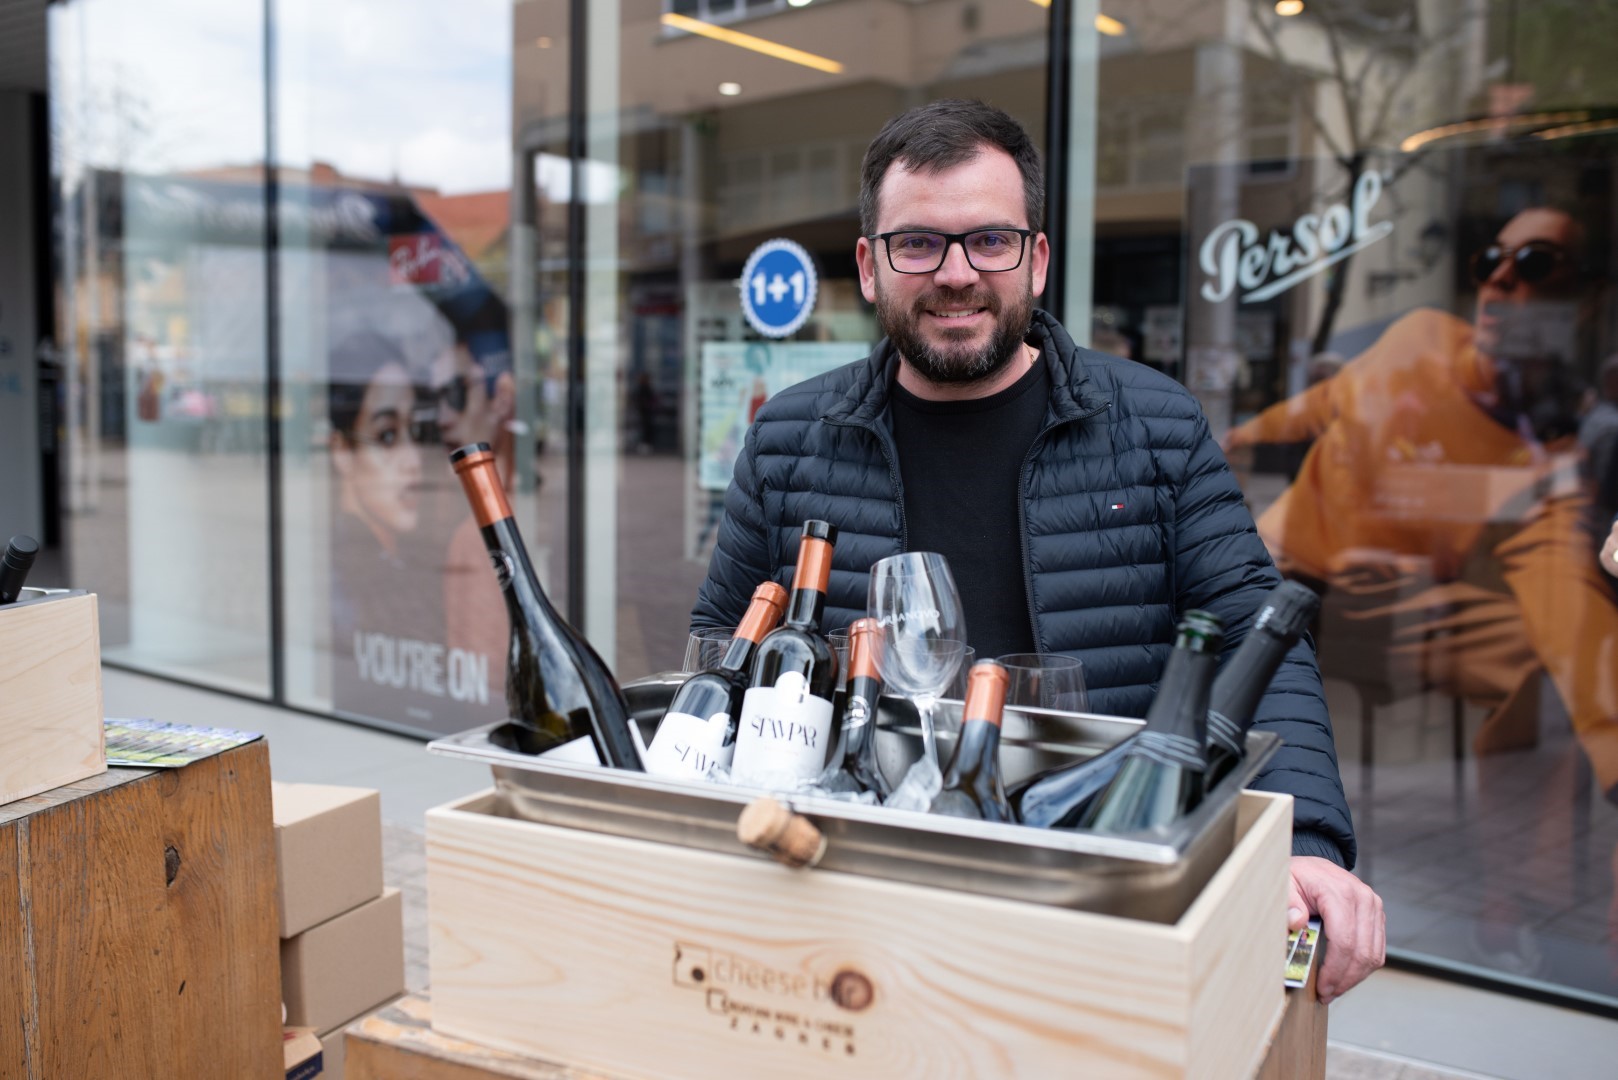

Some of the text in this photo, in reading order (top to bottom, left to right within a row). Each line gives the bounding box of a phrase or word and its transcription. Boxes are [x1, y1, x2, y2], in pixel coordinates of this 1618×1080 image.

[1200, 170, 1394, 303] Persol
[752, 270, 805, 305] 1+1
[448, 647, 490, 705] ON
